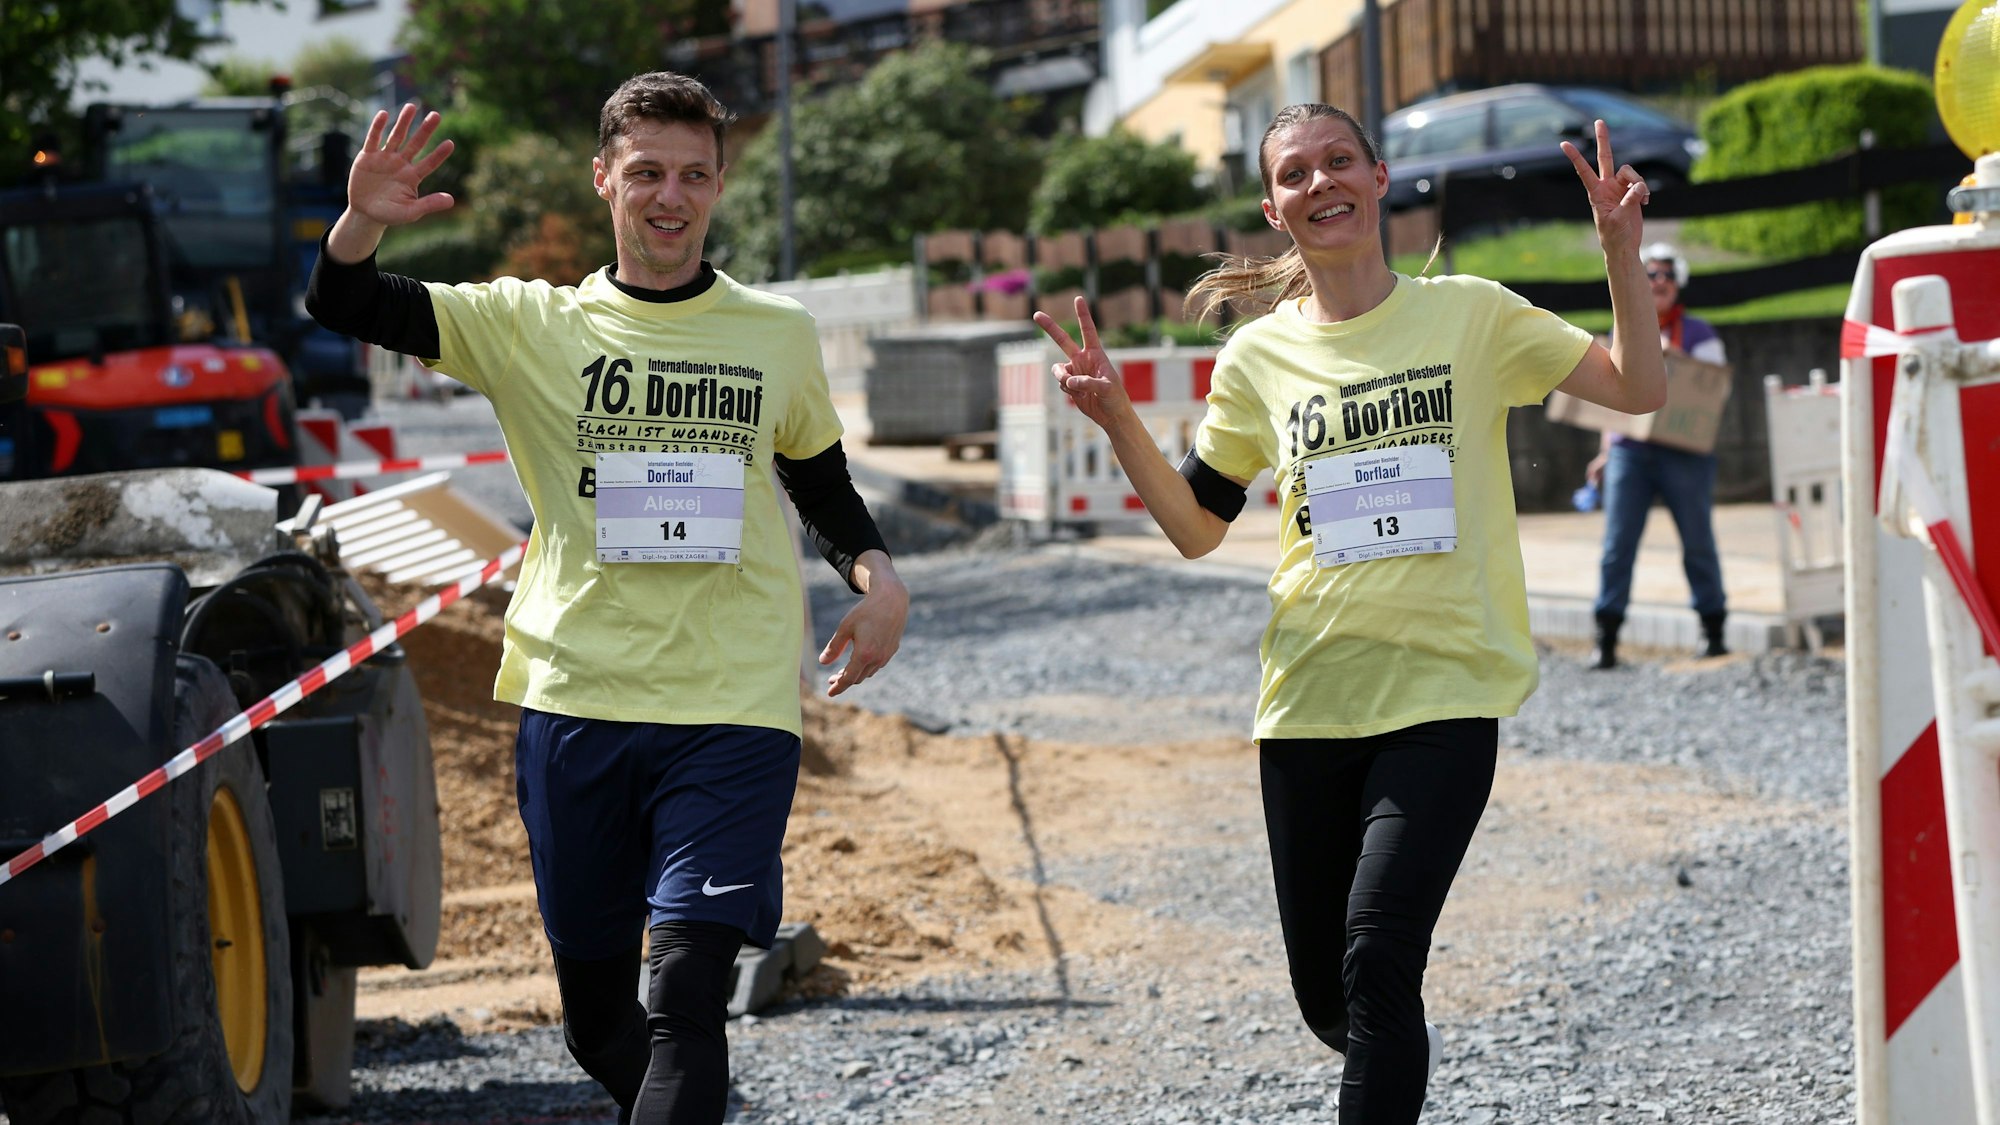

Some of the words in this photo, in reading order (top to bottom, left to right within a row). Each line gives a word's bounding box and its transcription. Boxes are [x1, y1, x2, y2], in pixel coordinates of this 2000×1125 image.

[648, 358, 717, 376] Internationaler
[718, 363, 763, 382] Biesfelder
[581, 355, 635, 415] 16.
[646, 374, 763, 427] Dorflauf
[1340, 372, 1405, 399] Internationaler
[1407, 364, 1451, 382] Biesfelder
[1287, 394, 1335, 457] 16.
[1342, 380, 1453, 442] Dorflauf
[577, 420, 628, 436] FLACH
[637, 427, 665, 438] IST
[672, 428, 756, 449] WOANDERS
[577, 438, 647, 453] Samstag
[661, 444, 753, 462] 23.05200
[648, 469, 694, 483] Dorflauf
[1355, 464, 1400, 483] Dorflauf
[643, 496, 701, 514] Alexej
[1355, 491, 1412, 511] Alesia
[660, 521, 687, 541] 14
[1373, 516, 1400, 537] 13
